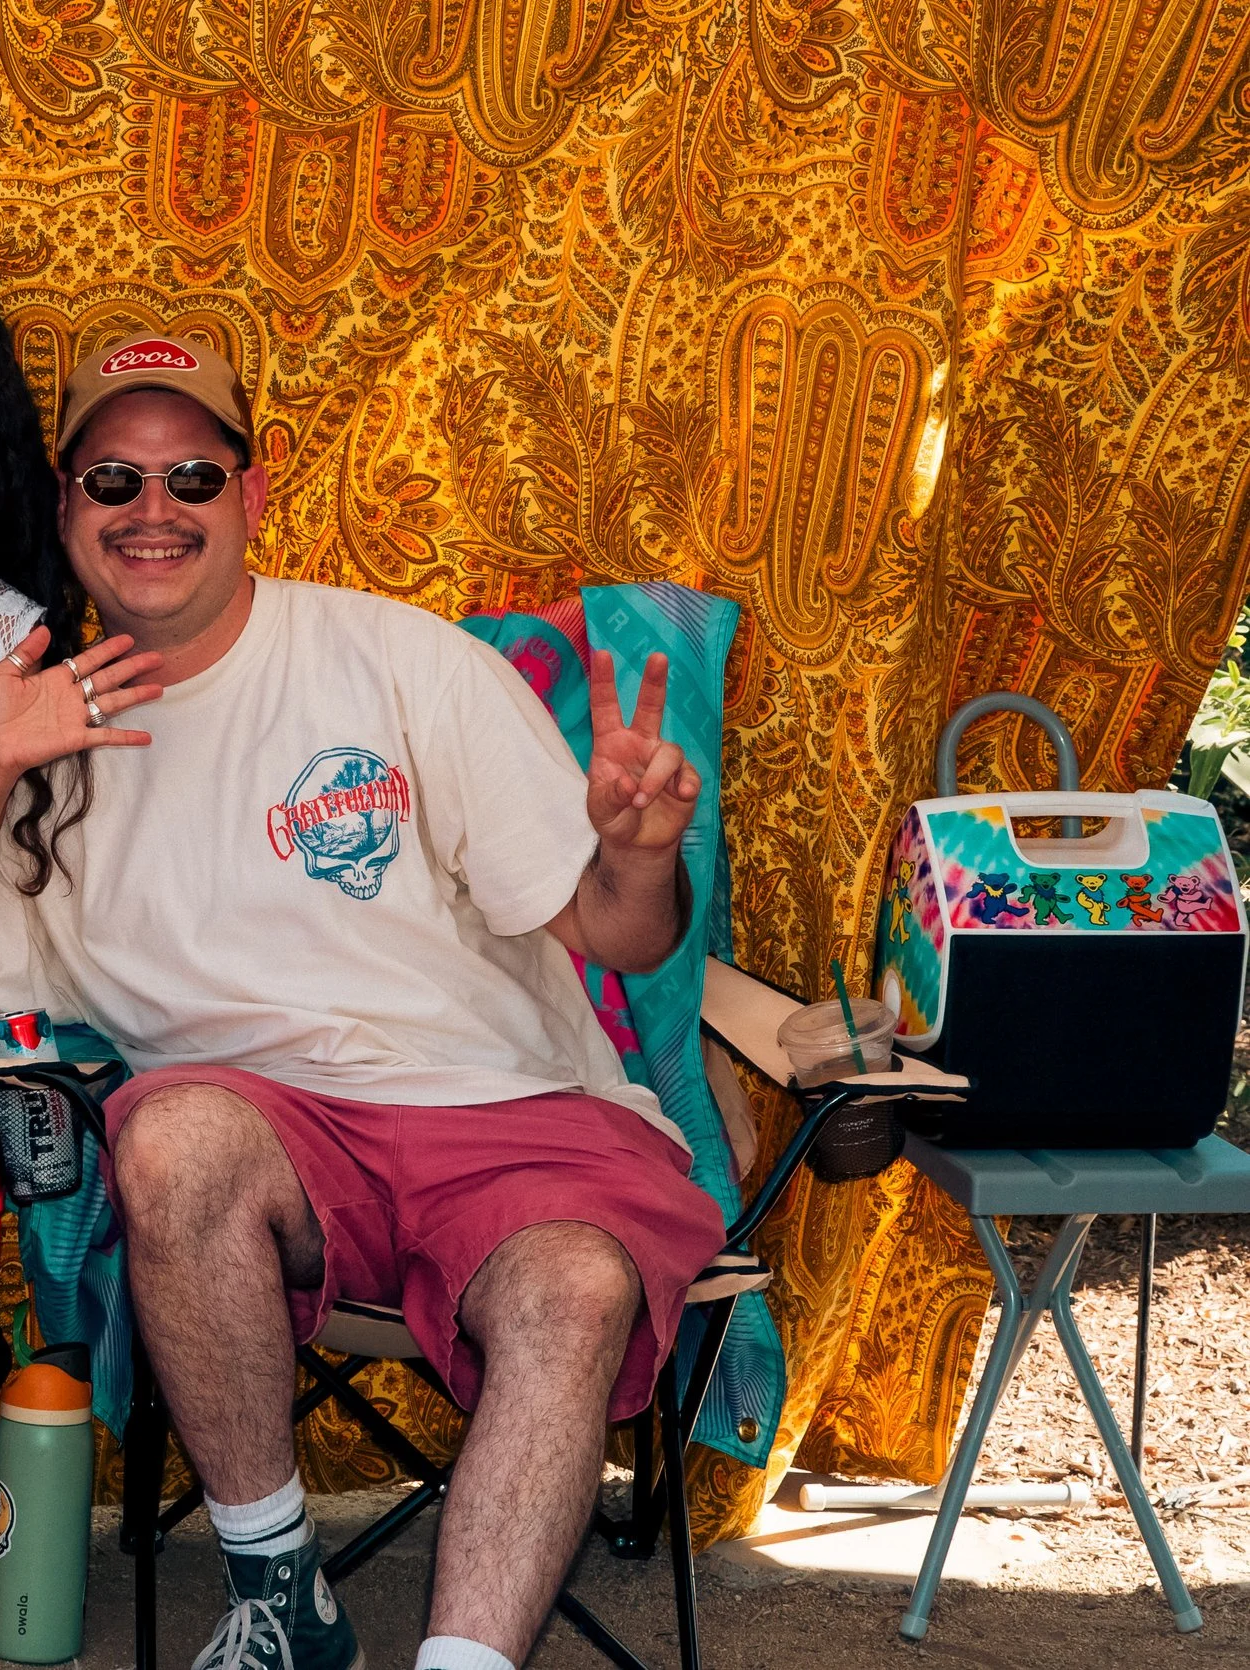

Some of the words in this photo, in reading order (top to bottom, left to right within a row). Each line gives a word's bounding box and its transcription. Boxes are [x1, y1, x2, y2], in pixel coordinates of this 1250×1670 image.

[110, 351, 187, 371] Coors
[24, 1092, 55, 1161] TRU
[16, 1594, 29, 1636] owala
